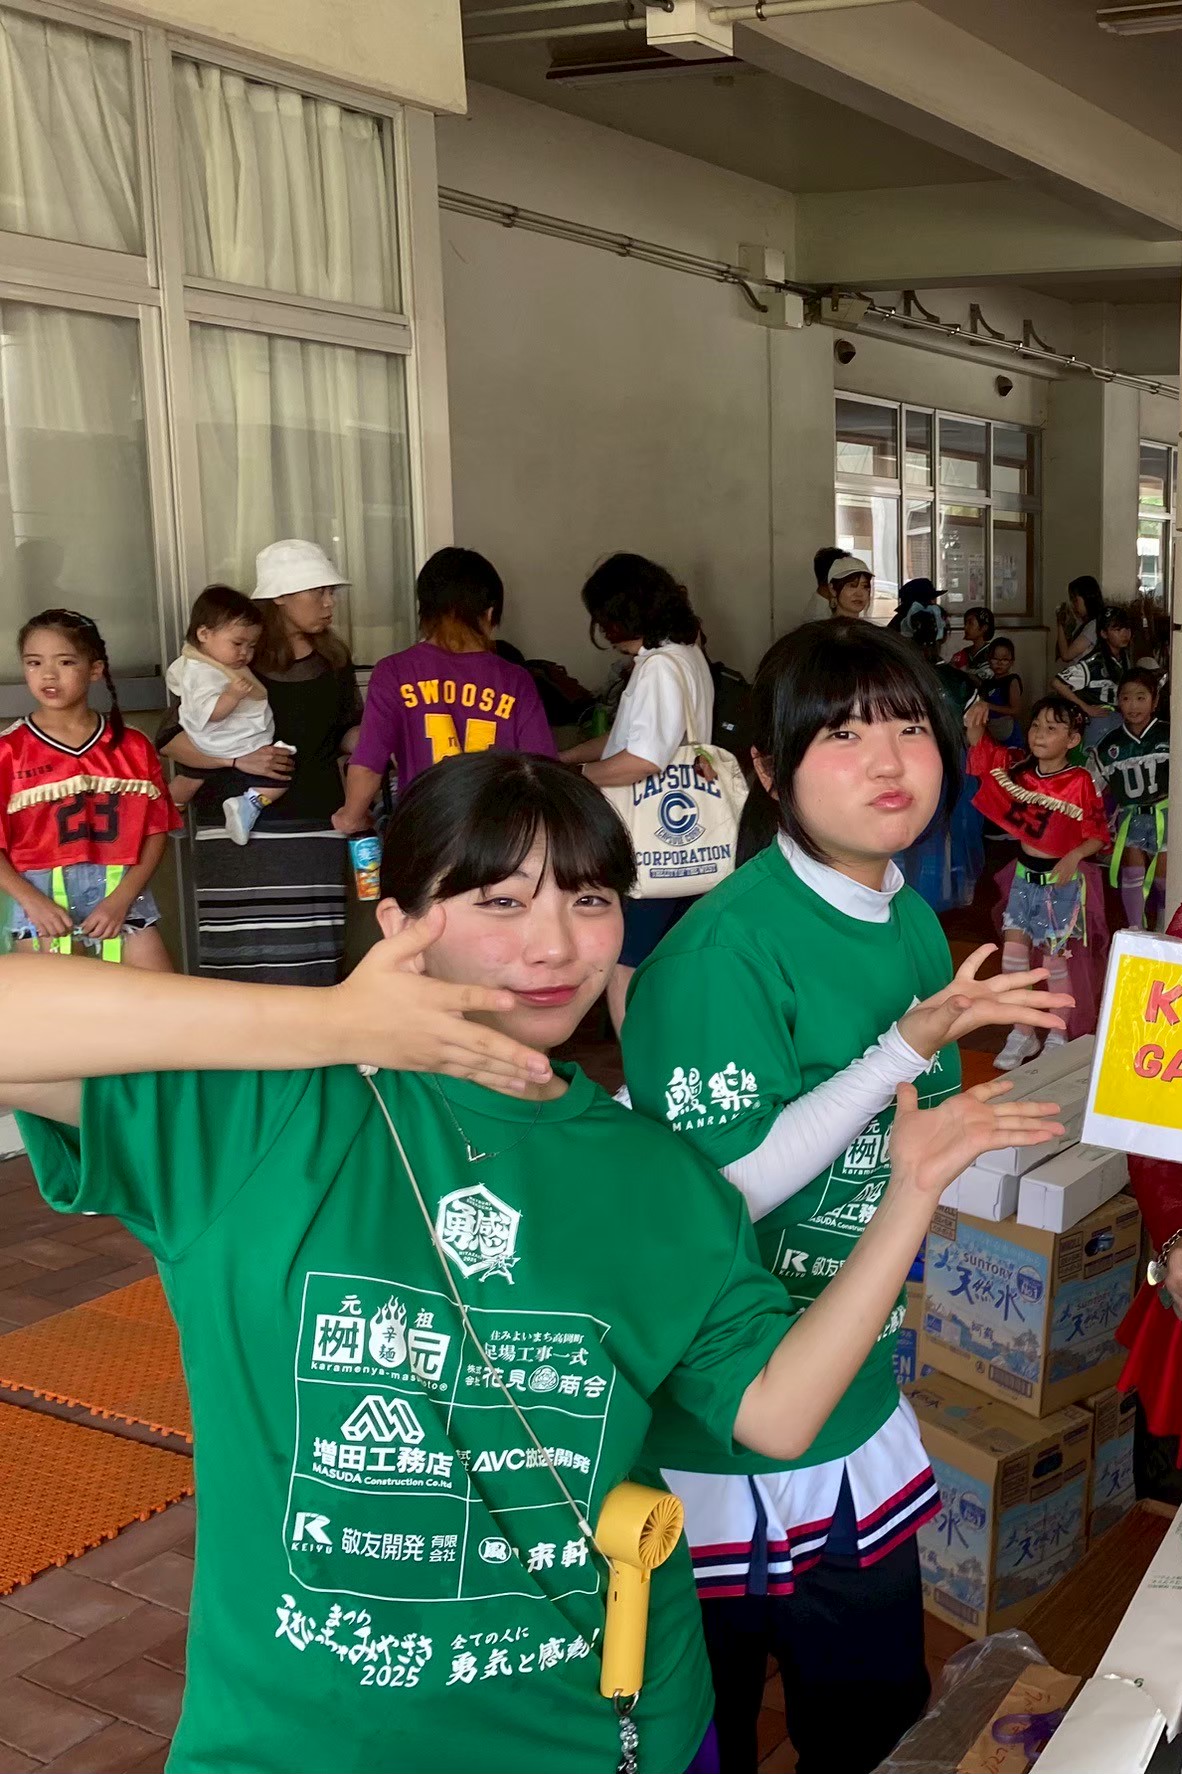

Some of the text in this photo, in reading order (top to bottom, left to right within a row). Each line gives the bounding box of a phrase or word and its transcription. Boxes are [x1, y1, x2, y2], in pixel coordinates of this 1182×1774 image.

[400, 679, 516, 719] SWOOSH
[57, 790, 119, 845] 23
[634, 844, 732, 866] CORPORATION
[963, 1252, 1013, 1280] SUNTORY
[484, 1342, 590, 1367] 足場工事一式
[557, 1373, 608, 1399] 商会
[313, 1436, 454, 1479] 増田工務店
[312, 1462, 363, 1484] MASUDA
[364, 1476, 424, 1487] Construction
[291, 1542, 334, 1555] KEIYU
[341, 1527, 426, 1562] 敬友開発
[429, 1549, 457, 1563] 会社
[325, 1603, 372, 1628] まつり
[450, 1626, 530, 1651] 全ての人に
[360, 1664, 422, 1688] 2025
